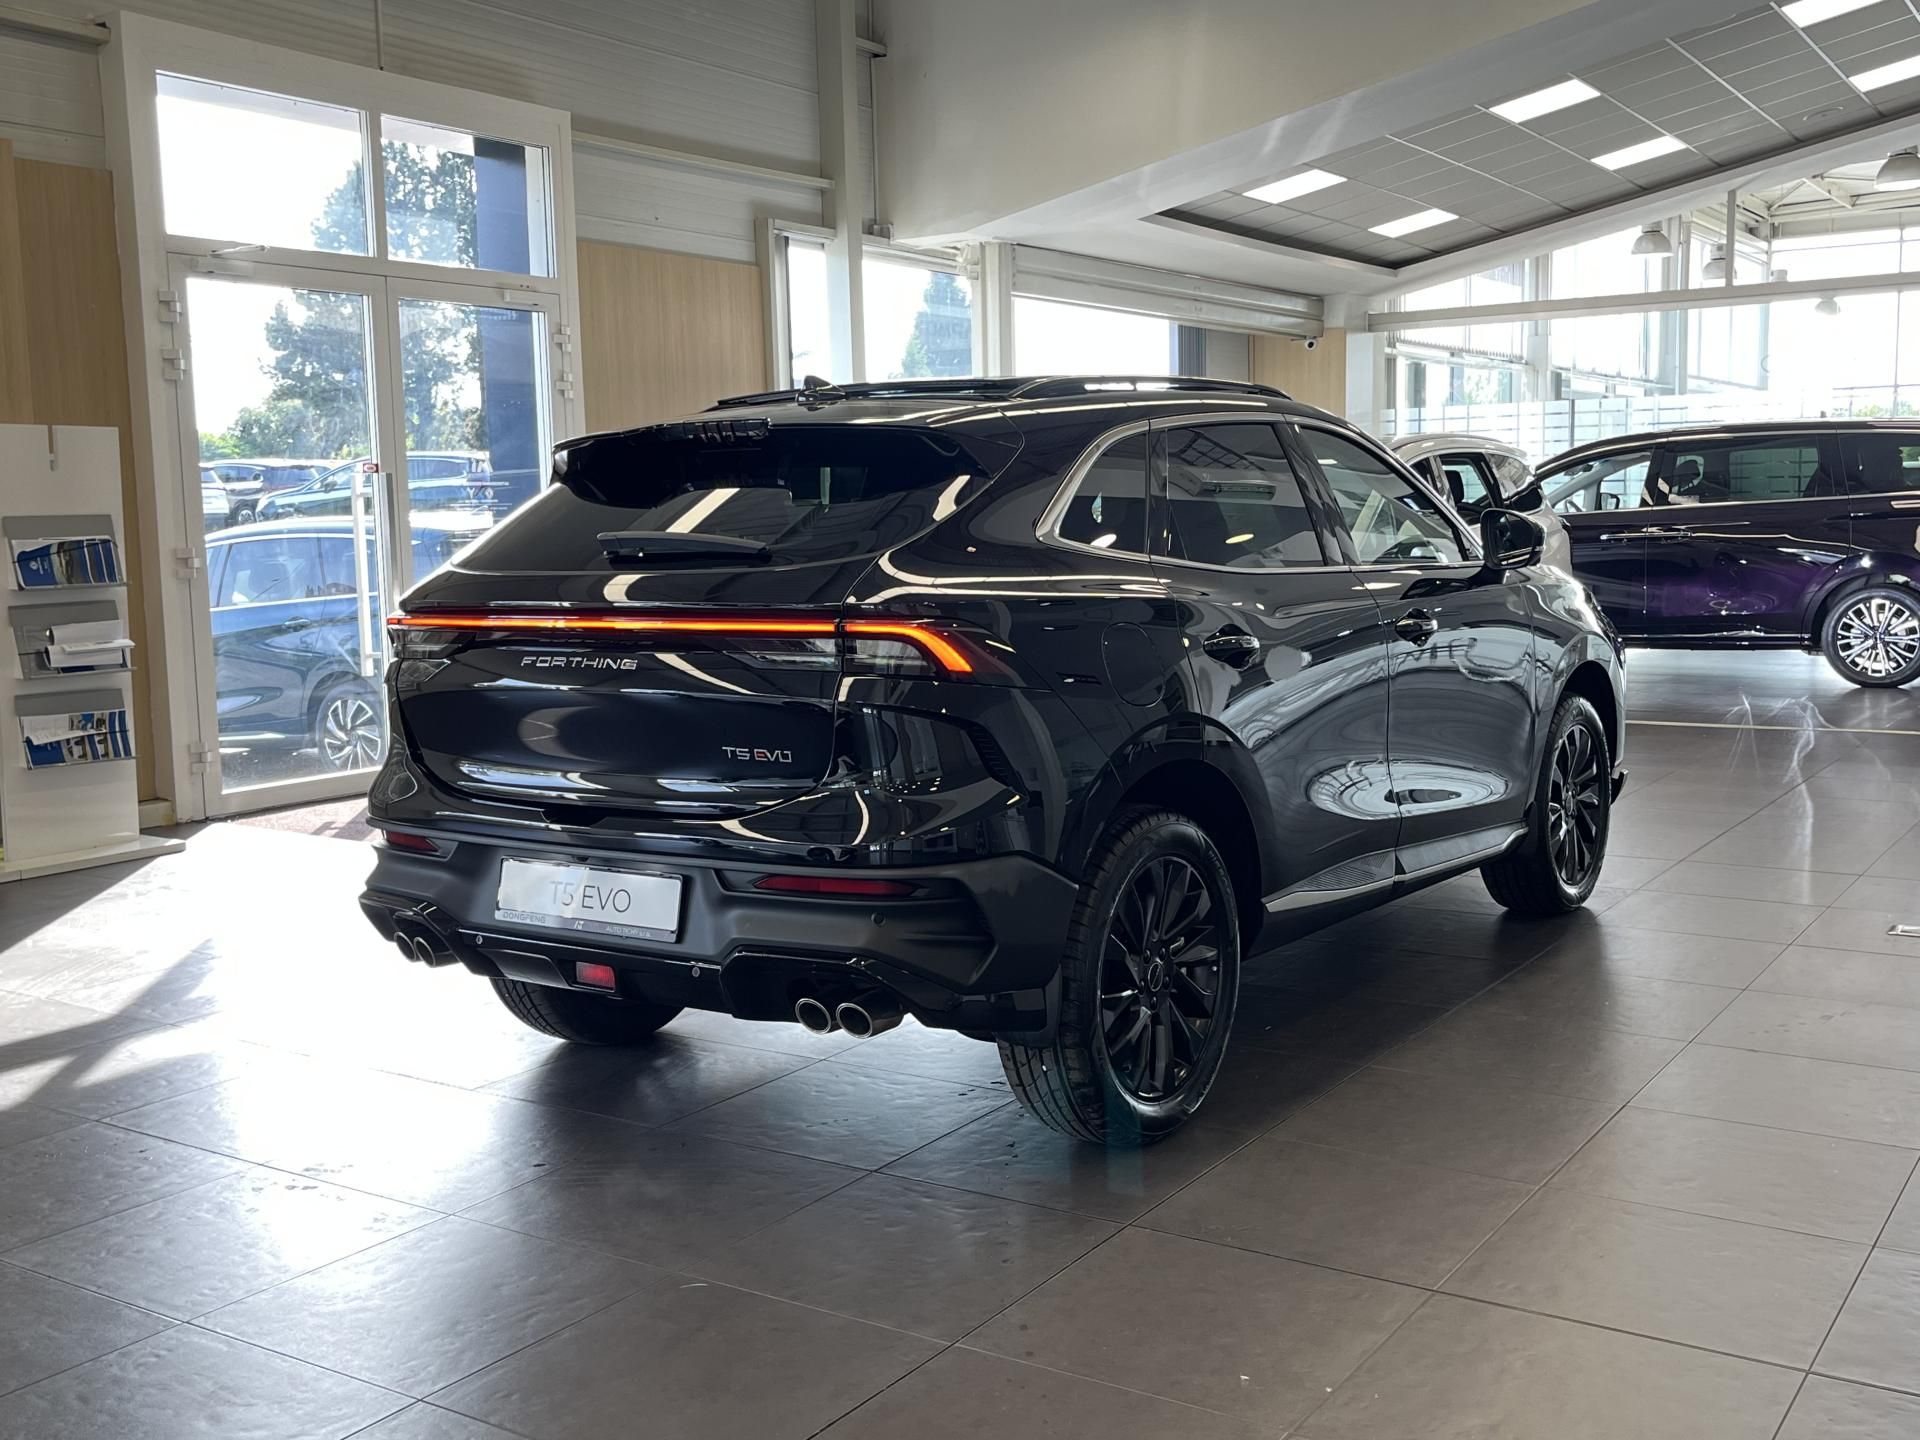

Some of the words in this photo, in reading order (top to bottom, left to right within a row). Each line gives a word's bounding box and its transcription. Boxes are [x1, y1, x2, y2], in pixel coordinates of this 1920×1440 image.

[520, 656, 638, 670] FORTHING
[754, 749, 792, 763] EVO
[549, 880, 575, 906] T5
[581, 885, 631, 914] EVO
[502, 911, 546, 924] DONGFENG
